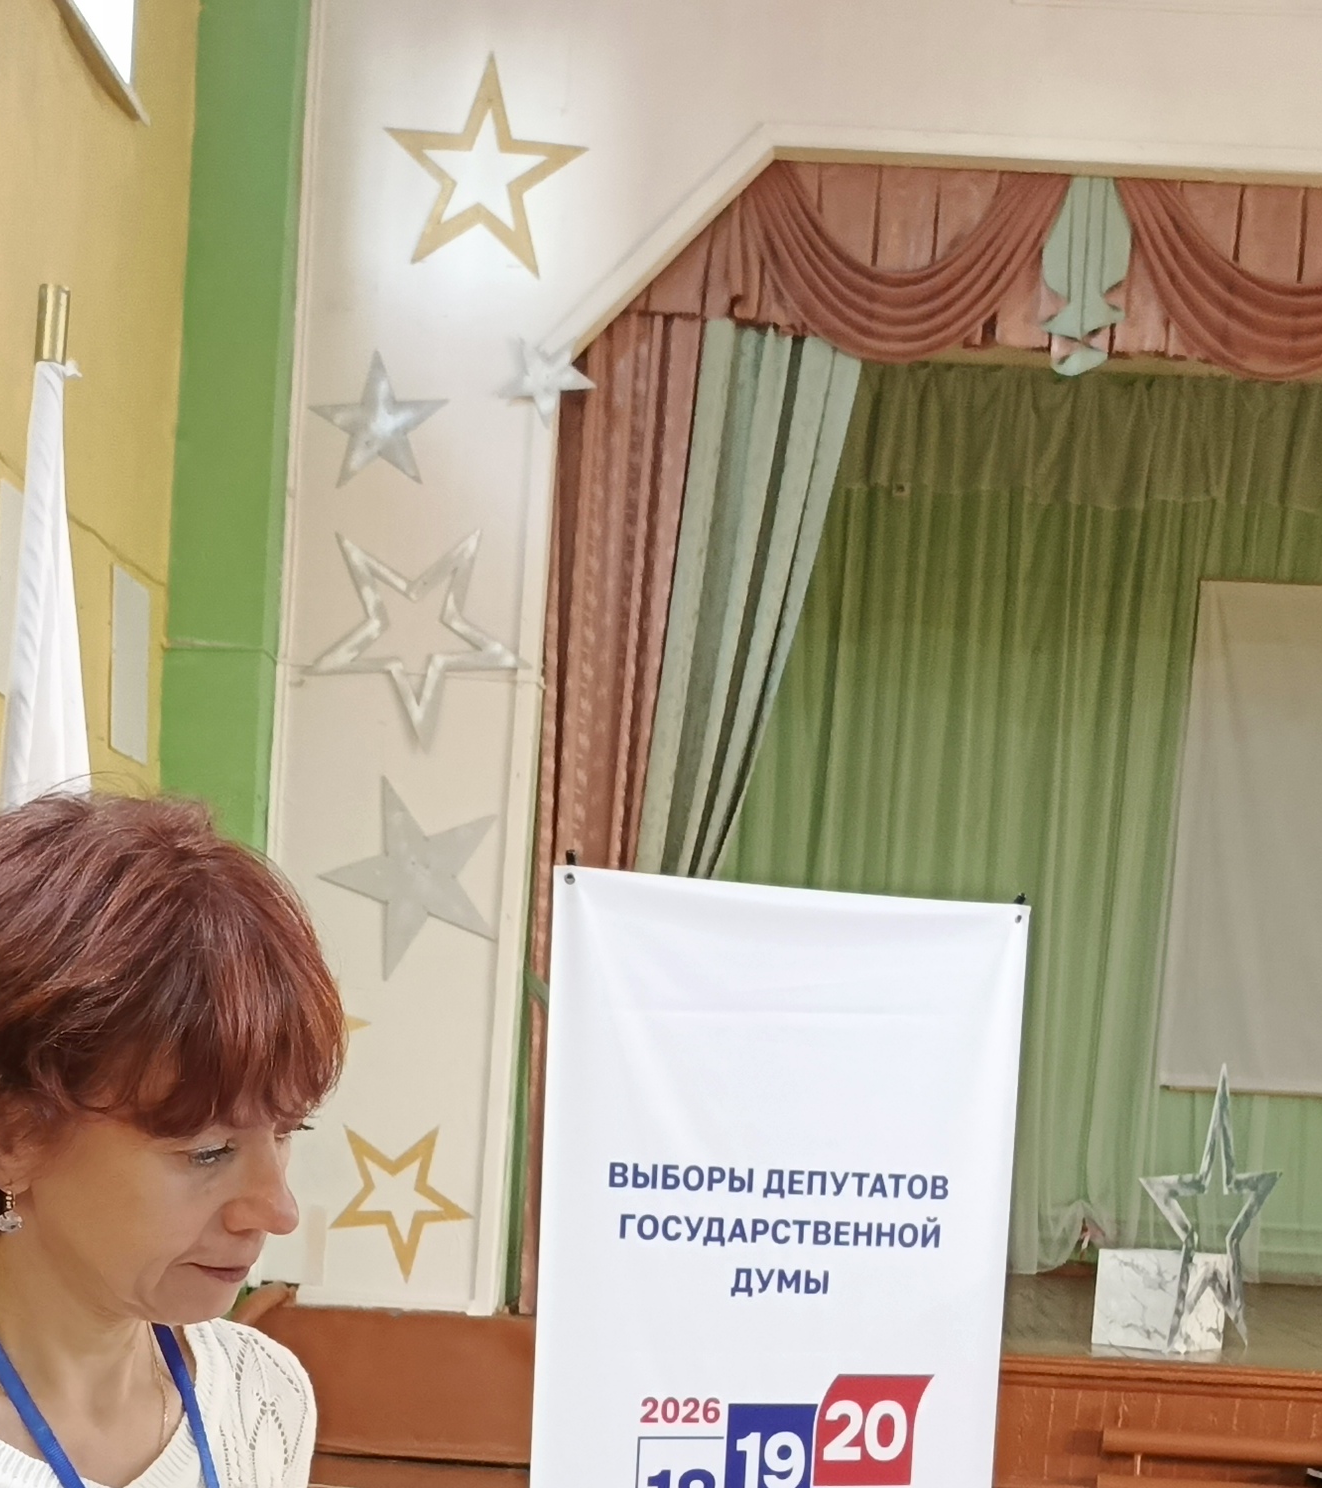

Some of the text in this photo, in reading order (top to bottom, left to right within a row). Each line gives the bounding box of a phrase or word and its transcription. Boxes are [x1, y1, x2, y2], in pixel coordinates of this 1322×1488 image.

[609, 1162, 949, 1201] ВЫБОРЫ ДЕПУТАТОВ
[618, 1214, 941, 1249] ГОСУДАРСТВЕННОЙ
[730, 1268, 830, 1298] ДУМЫ
[640, 1397, 721, 1425] 2026
[824, 1400, 907, 1462] 20
